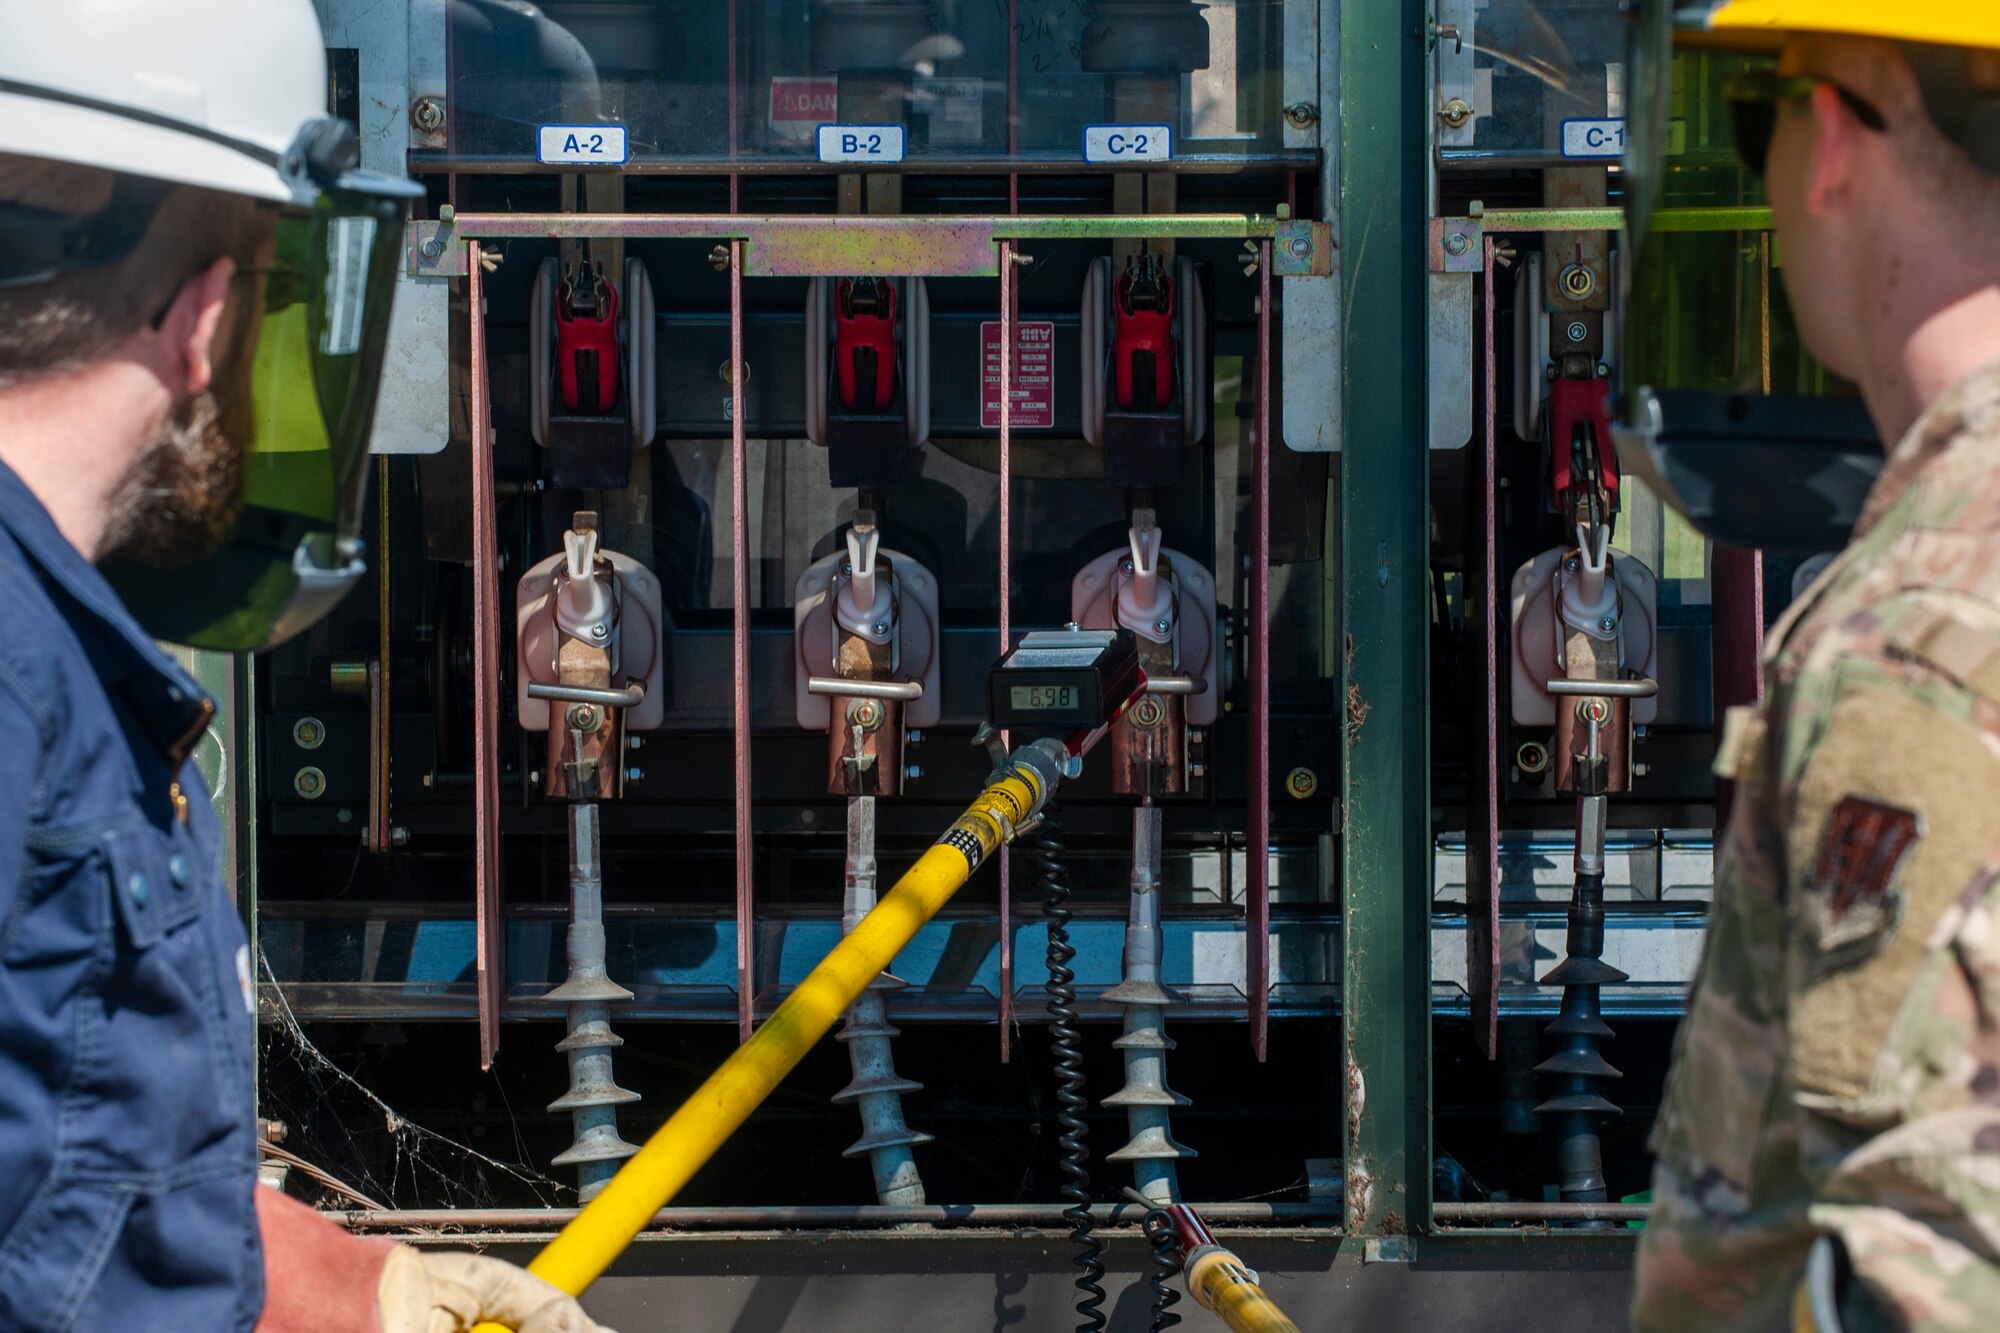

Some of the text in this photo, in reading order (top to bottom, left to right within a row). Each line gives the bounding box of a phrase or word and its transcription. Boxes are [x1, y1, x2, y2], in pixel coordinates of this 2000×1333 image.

[797, 94, 838, 111] DAN
[563, 134, 603, 154] A-2
[841, 134, 882, 154] B-2
[1107, 134, 1148, 154] C-2
[1586, 127, 1625, 148] C-1
[1021, 328, 1051, 341] ABB
[1031, 687, 1070, 707] 6.98
